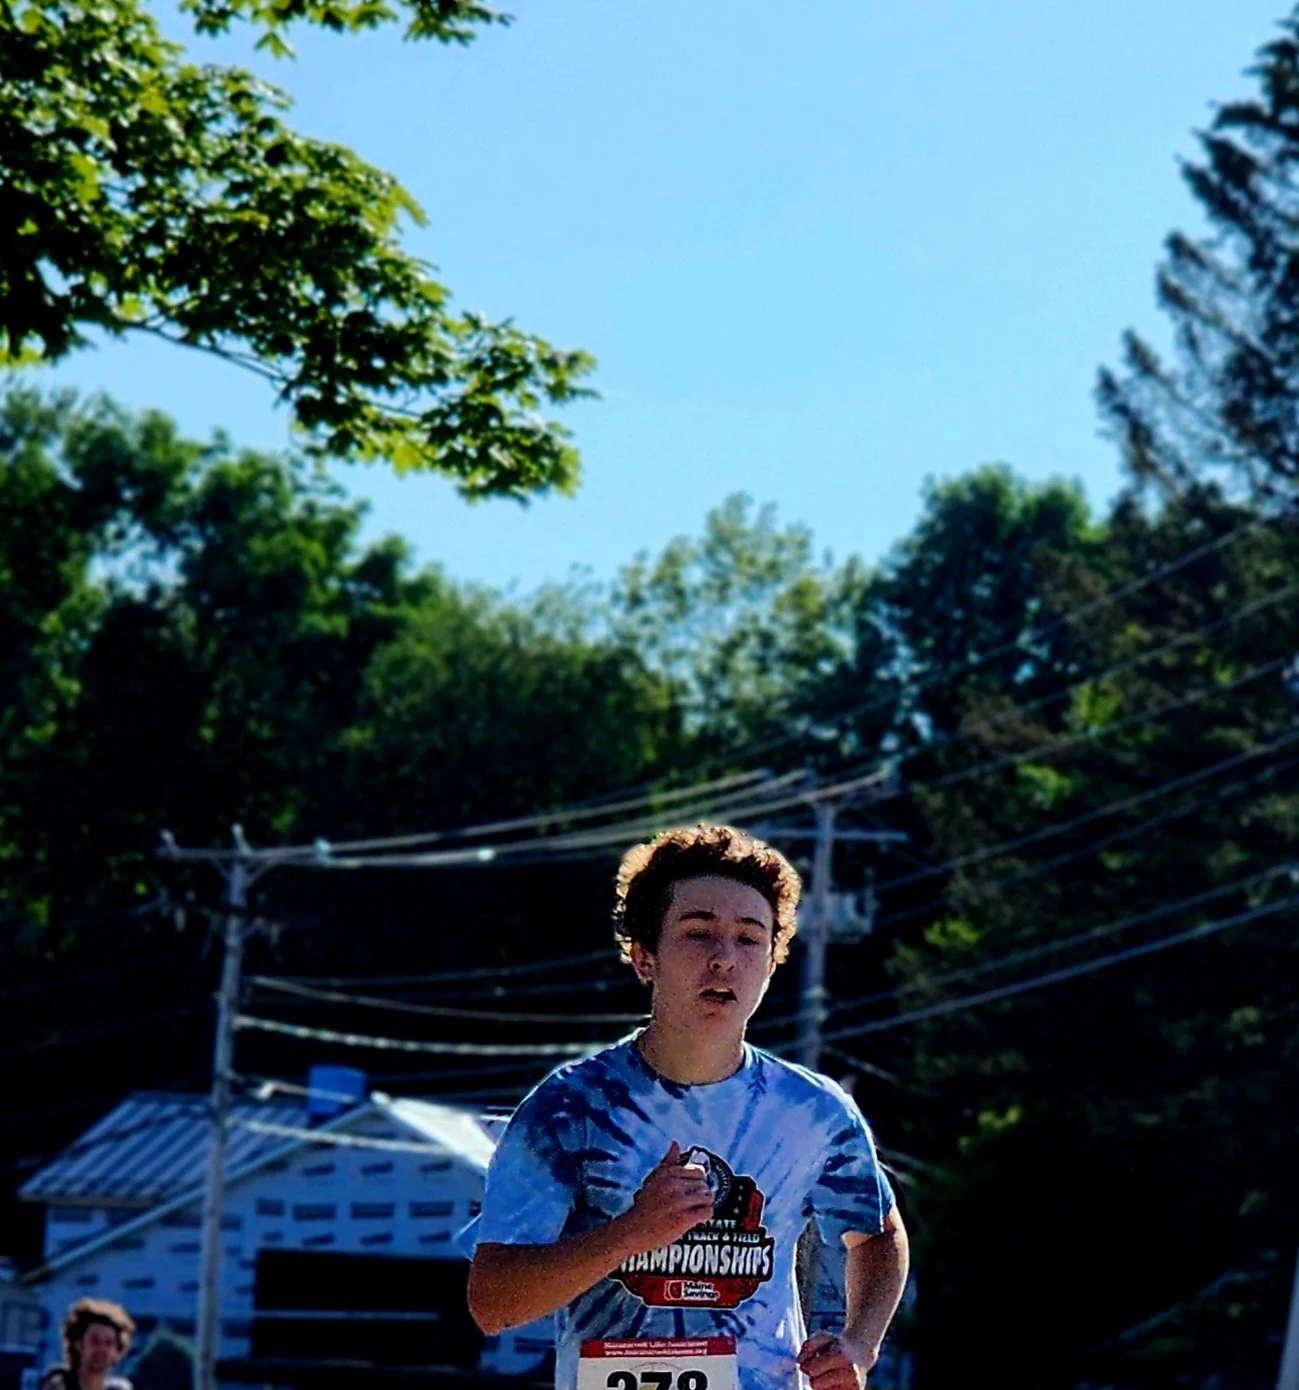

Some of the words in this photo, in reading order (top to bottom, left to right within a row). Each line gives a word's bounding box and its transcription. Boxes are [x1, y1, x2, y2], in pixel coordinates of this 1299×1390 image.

[687, 1231, 720, 1242] TRACK
[733, 1232, 760, 1243] FIELD
[620, 1244, 772, 1276] HAMPIONSHIPS
